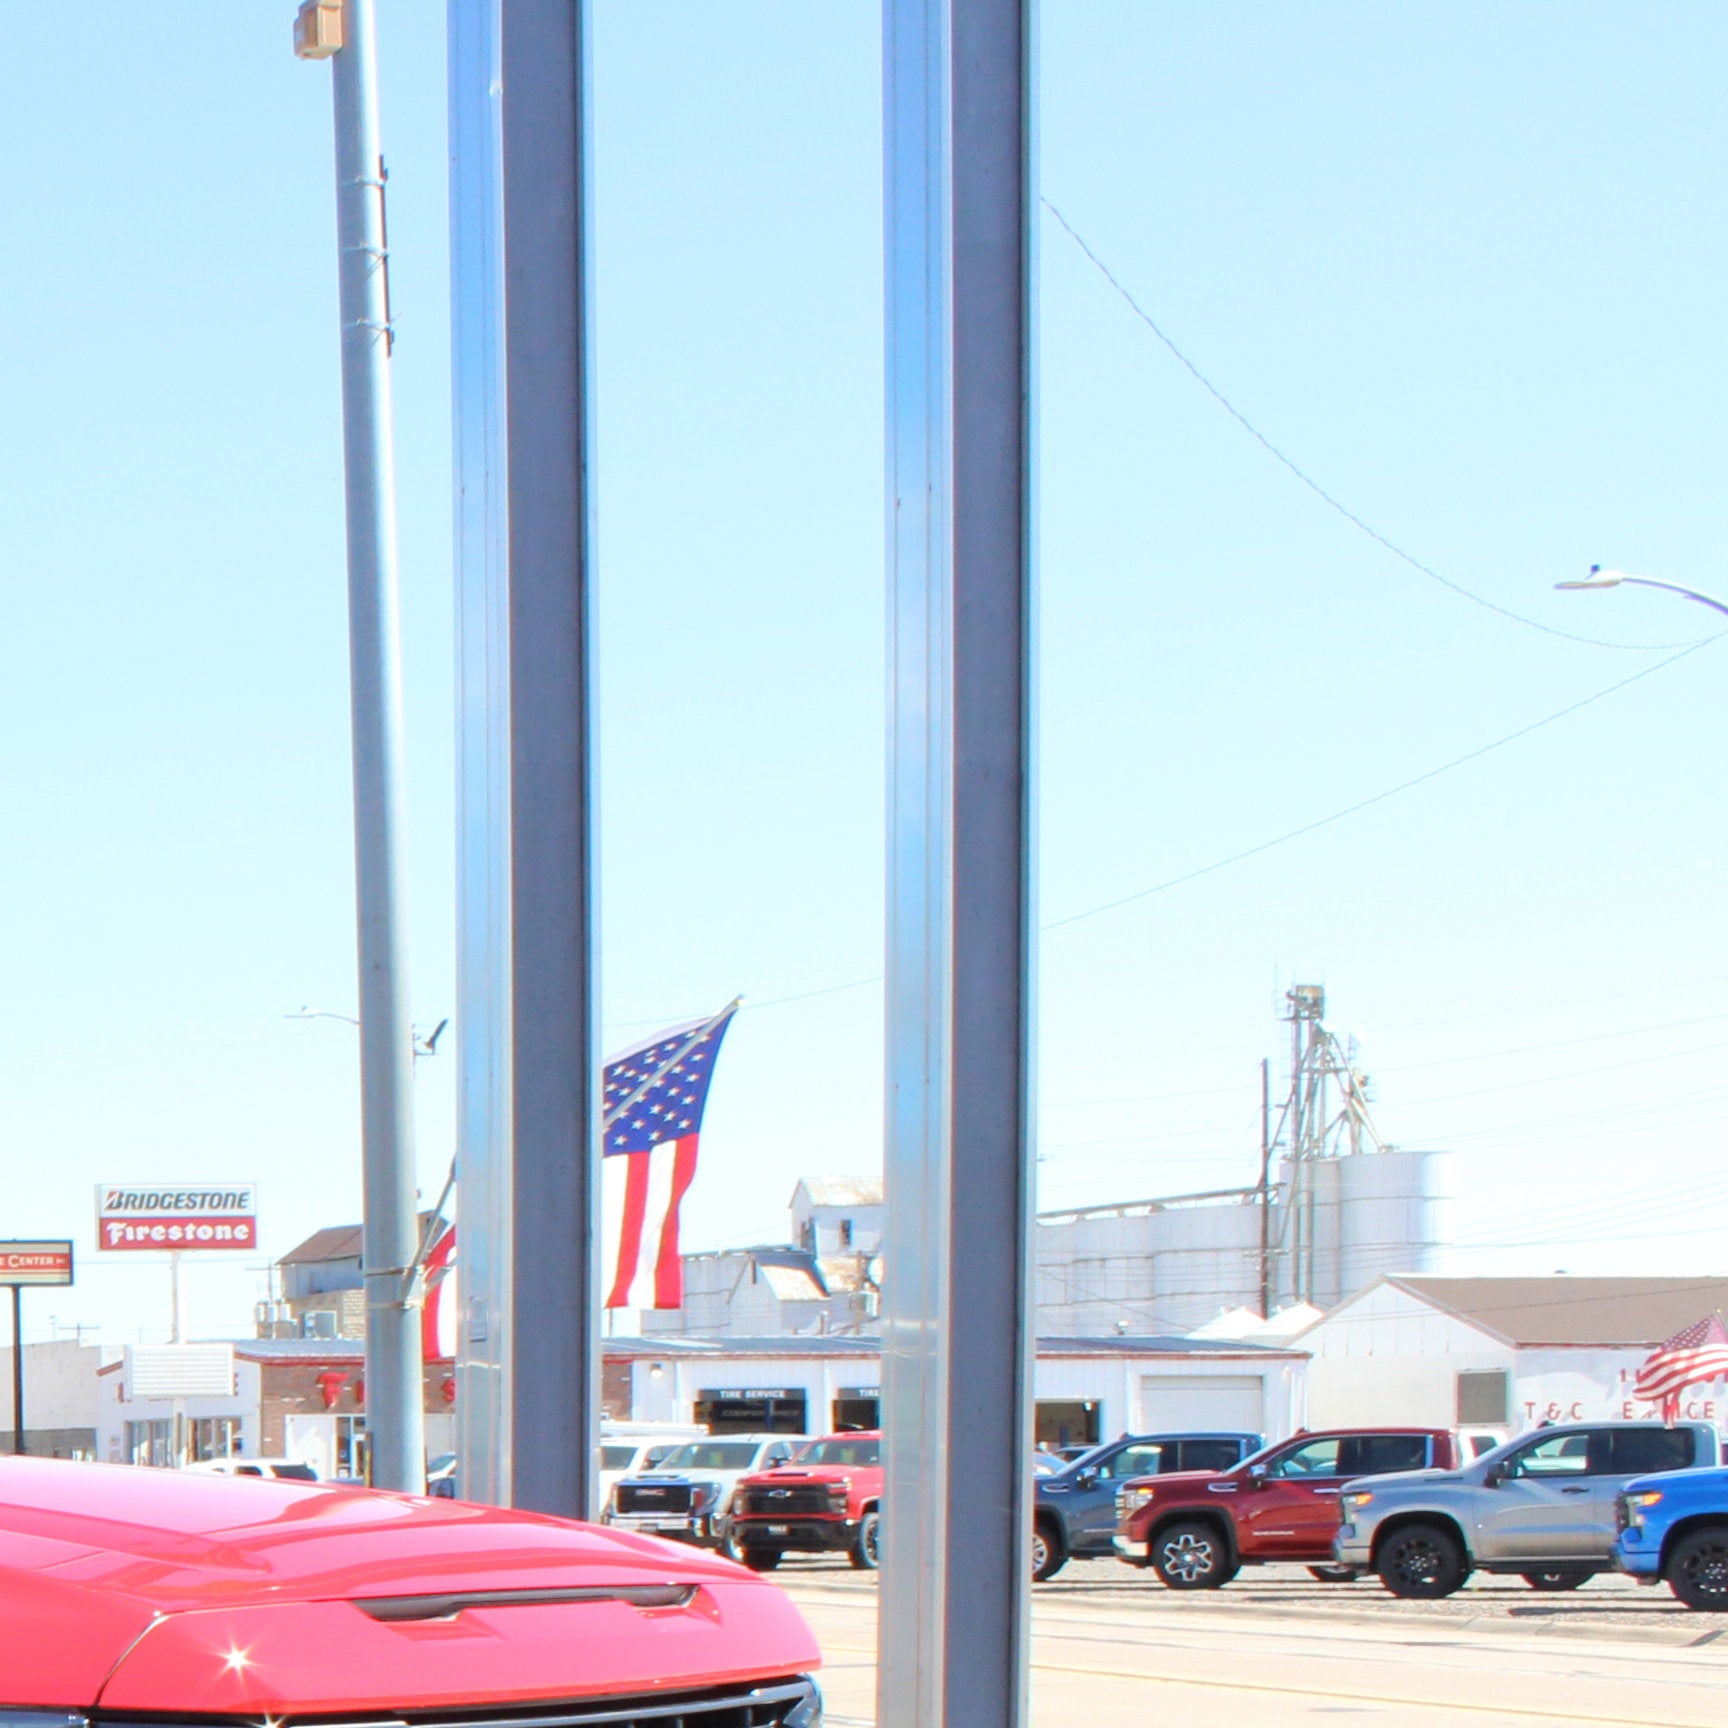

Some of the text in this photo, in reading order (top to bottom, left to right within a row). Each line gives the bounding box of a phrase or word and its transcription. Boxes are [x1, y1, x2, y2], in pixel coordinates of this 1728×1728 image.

[105, 1191, 250, 1210] BRIDGESTONE
[106, 1222, 250, 1246] Firestone
[8, 1255, 54, 1268] CENTER
[720, 1390, 786, 1399] TIRE SERVICE
[1524, 1402, 1536, 1420] T
[1571, 1402, 1583, 1420] C
